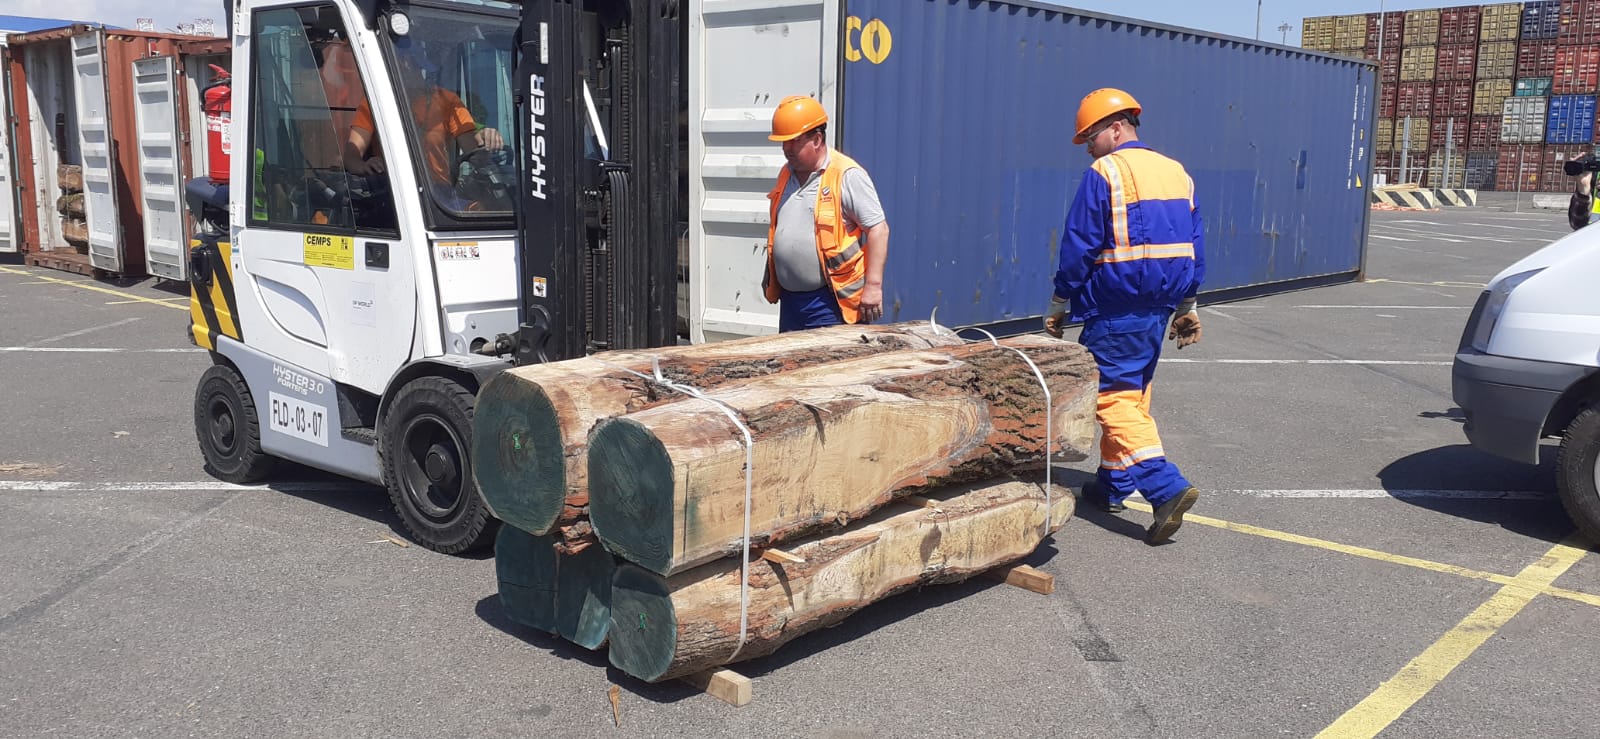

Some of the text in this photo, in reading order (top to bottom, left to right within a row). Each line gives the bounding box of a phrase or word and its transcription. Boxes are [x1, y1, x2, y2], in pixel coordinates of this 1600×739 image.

[530, 73, 547, 200] HYSTER
[306, 235, 332, 247] CEMPS
[272, 362, 324, 395] HYSTER 3.0
[273, 399, 289, 428] FLD
[295, 405, 306, 433] 03
[312, 410, 322, 438] 07
